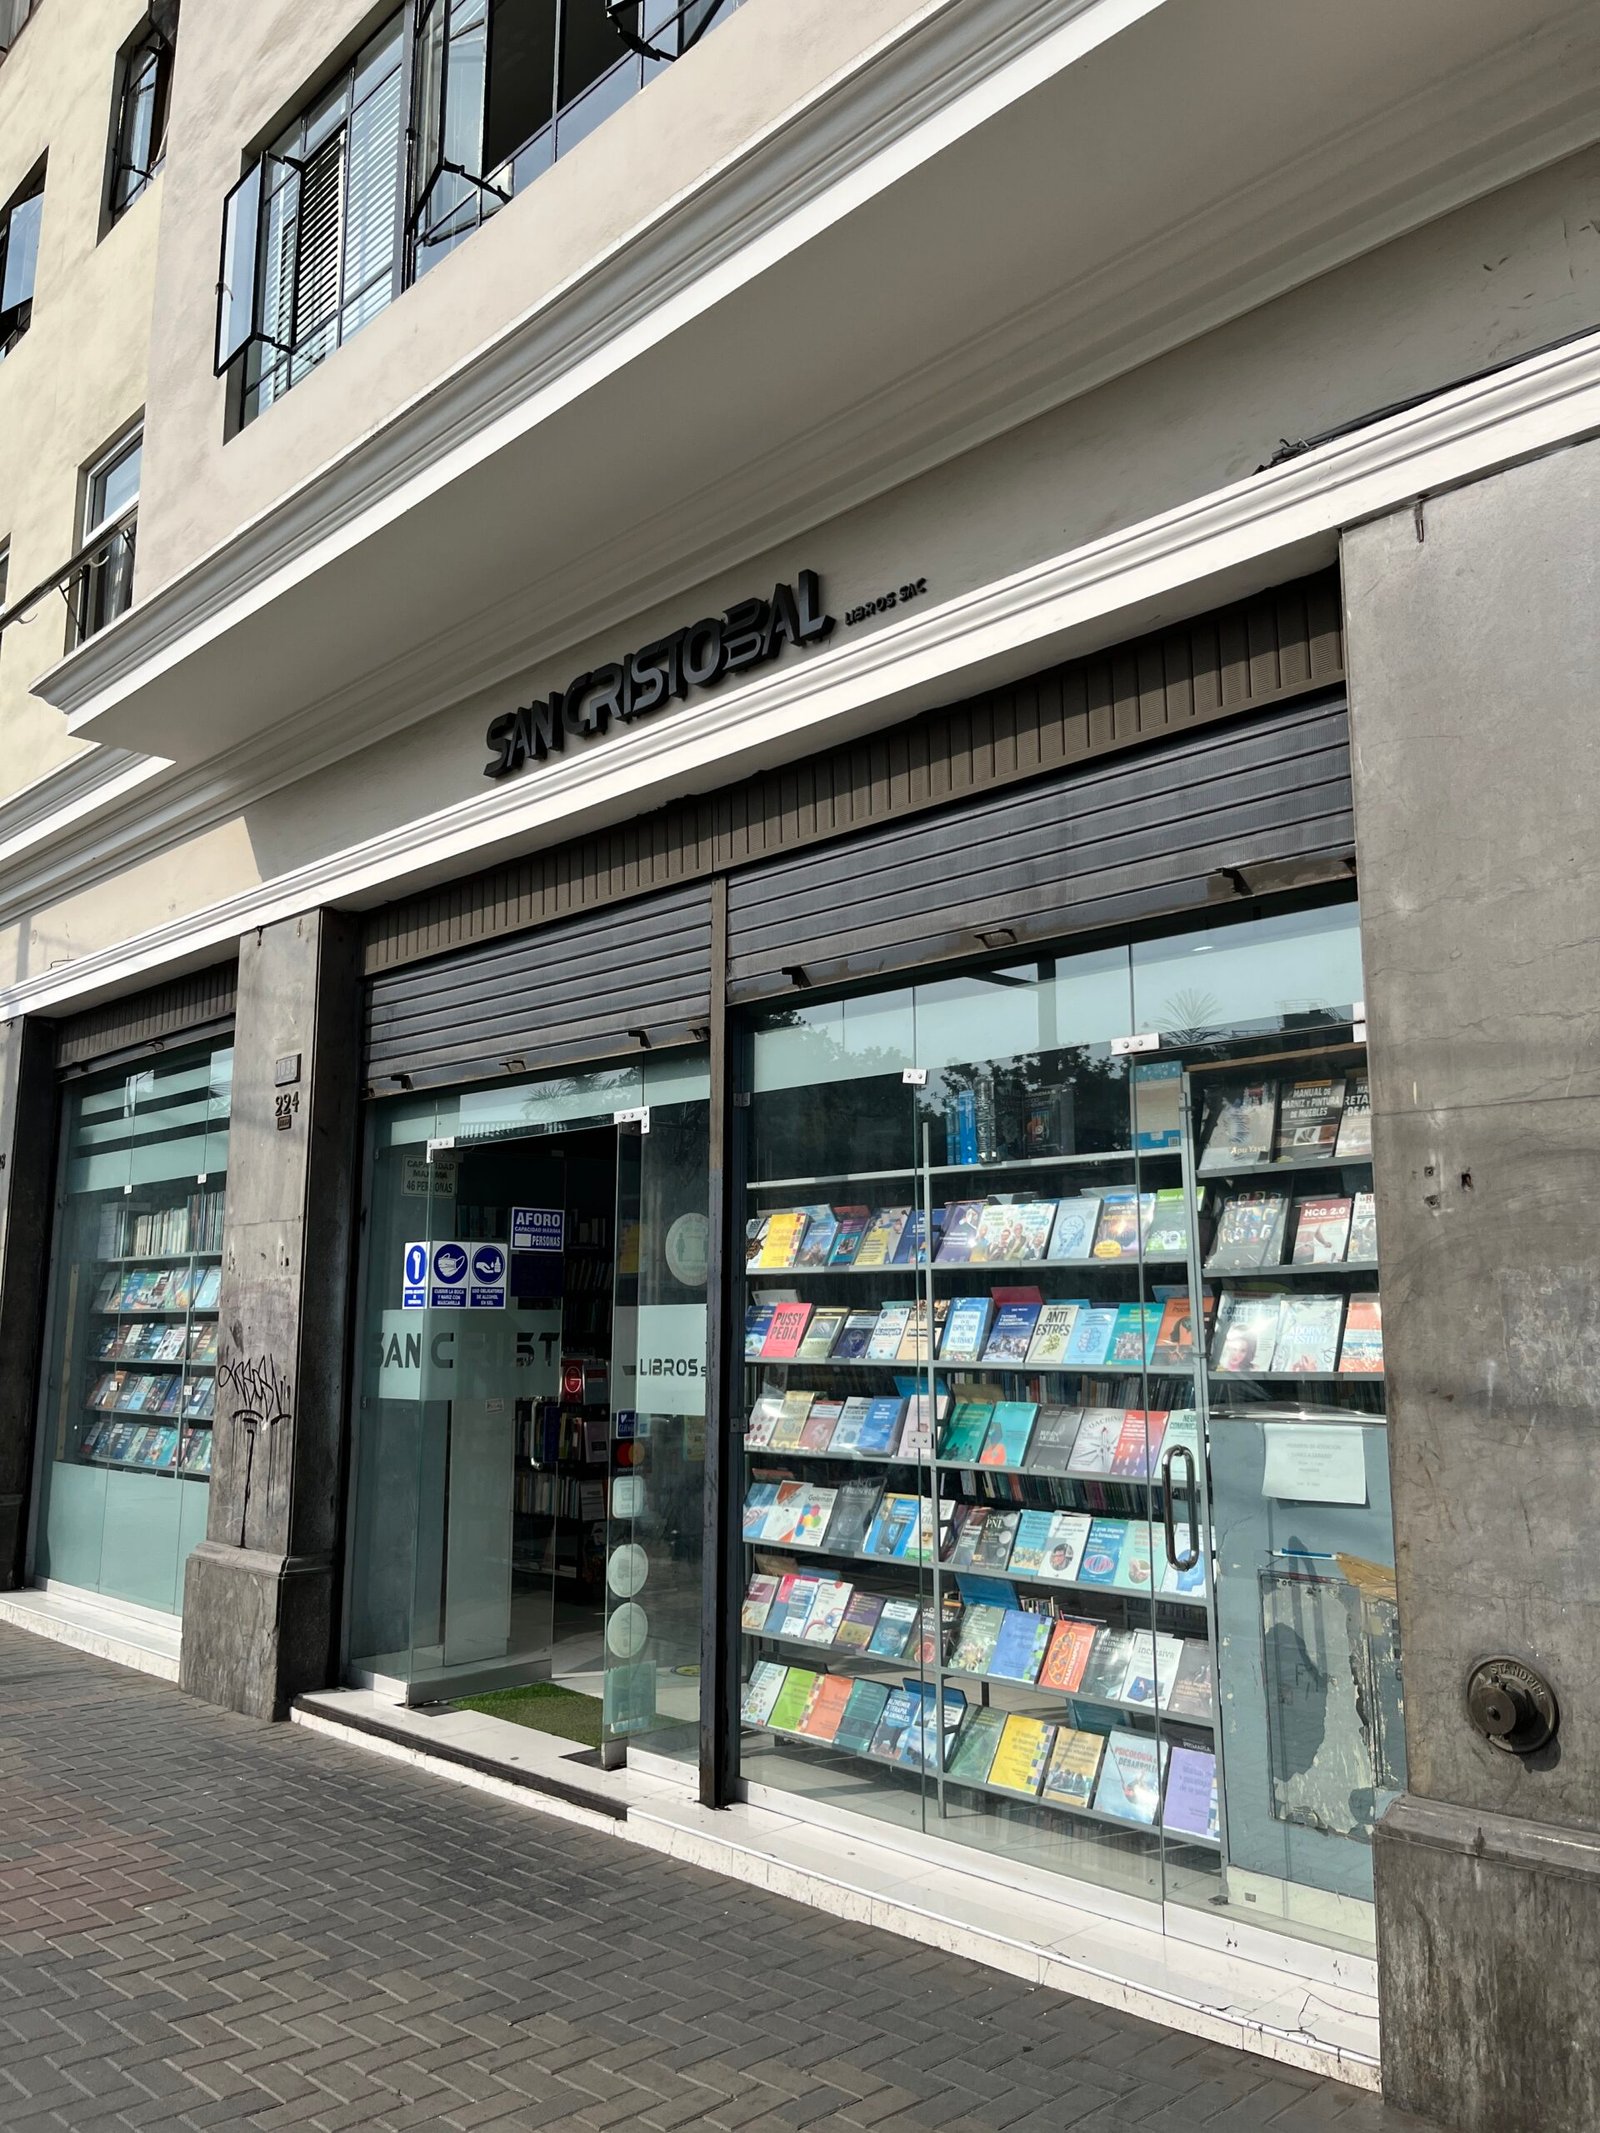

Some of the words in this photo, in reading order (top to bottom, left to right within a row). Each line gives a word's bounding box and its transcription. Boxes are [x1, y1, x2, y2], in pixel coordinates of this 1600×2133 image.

[845, 591, 897, 626] LIBROS
[899, 577, 928, 603] SAC
[484, 691, 564, 778] SAN
[562, 568, 836, 737] CRISTOBAL
[1293, 1087, 1322, 1098] MANUAL
[275, 1091, 300, 1117] 224
[1311, 1096, 1340, 1108] PINTURA
[1344, 1095, 1369, 1106] RETA
[1298, 1107, 1329, 1118] MUEBLES
[407, 1159, 455, 1171] CAPIDAD
[416, 1181, 453, 1193] PERONAS
[1304, 1208, 1327, 1217] HCG
[1330, 1207, 1346, 1215] 2.0
[515, 1211, 561, 1227] AFORO
[531, 1235, 561, 1247] PERSONAS
[774, 1312, 804, 1326] PUSSY
[1046, 1311, 1069, 1323] ANTI
[769, 1326, 799, 1340] PEDIA
[640, 1358, 698, 1377] LIBROS
[808, 1494, 834, 1503] Goleman
[1490, 1662, 1546, 1699] STANDPIP
[1119, 1757, 1158, 1773] DESARROLL
